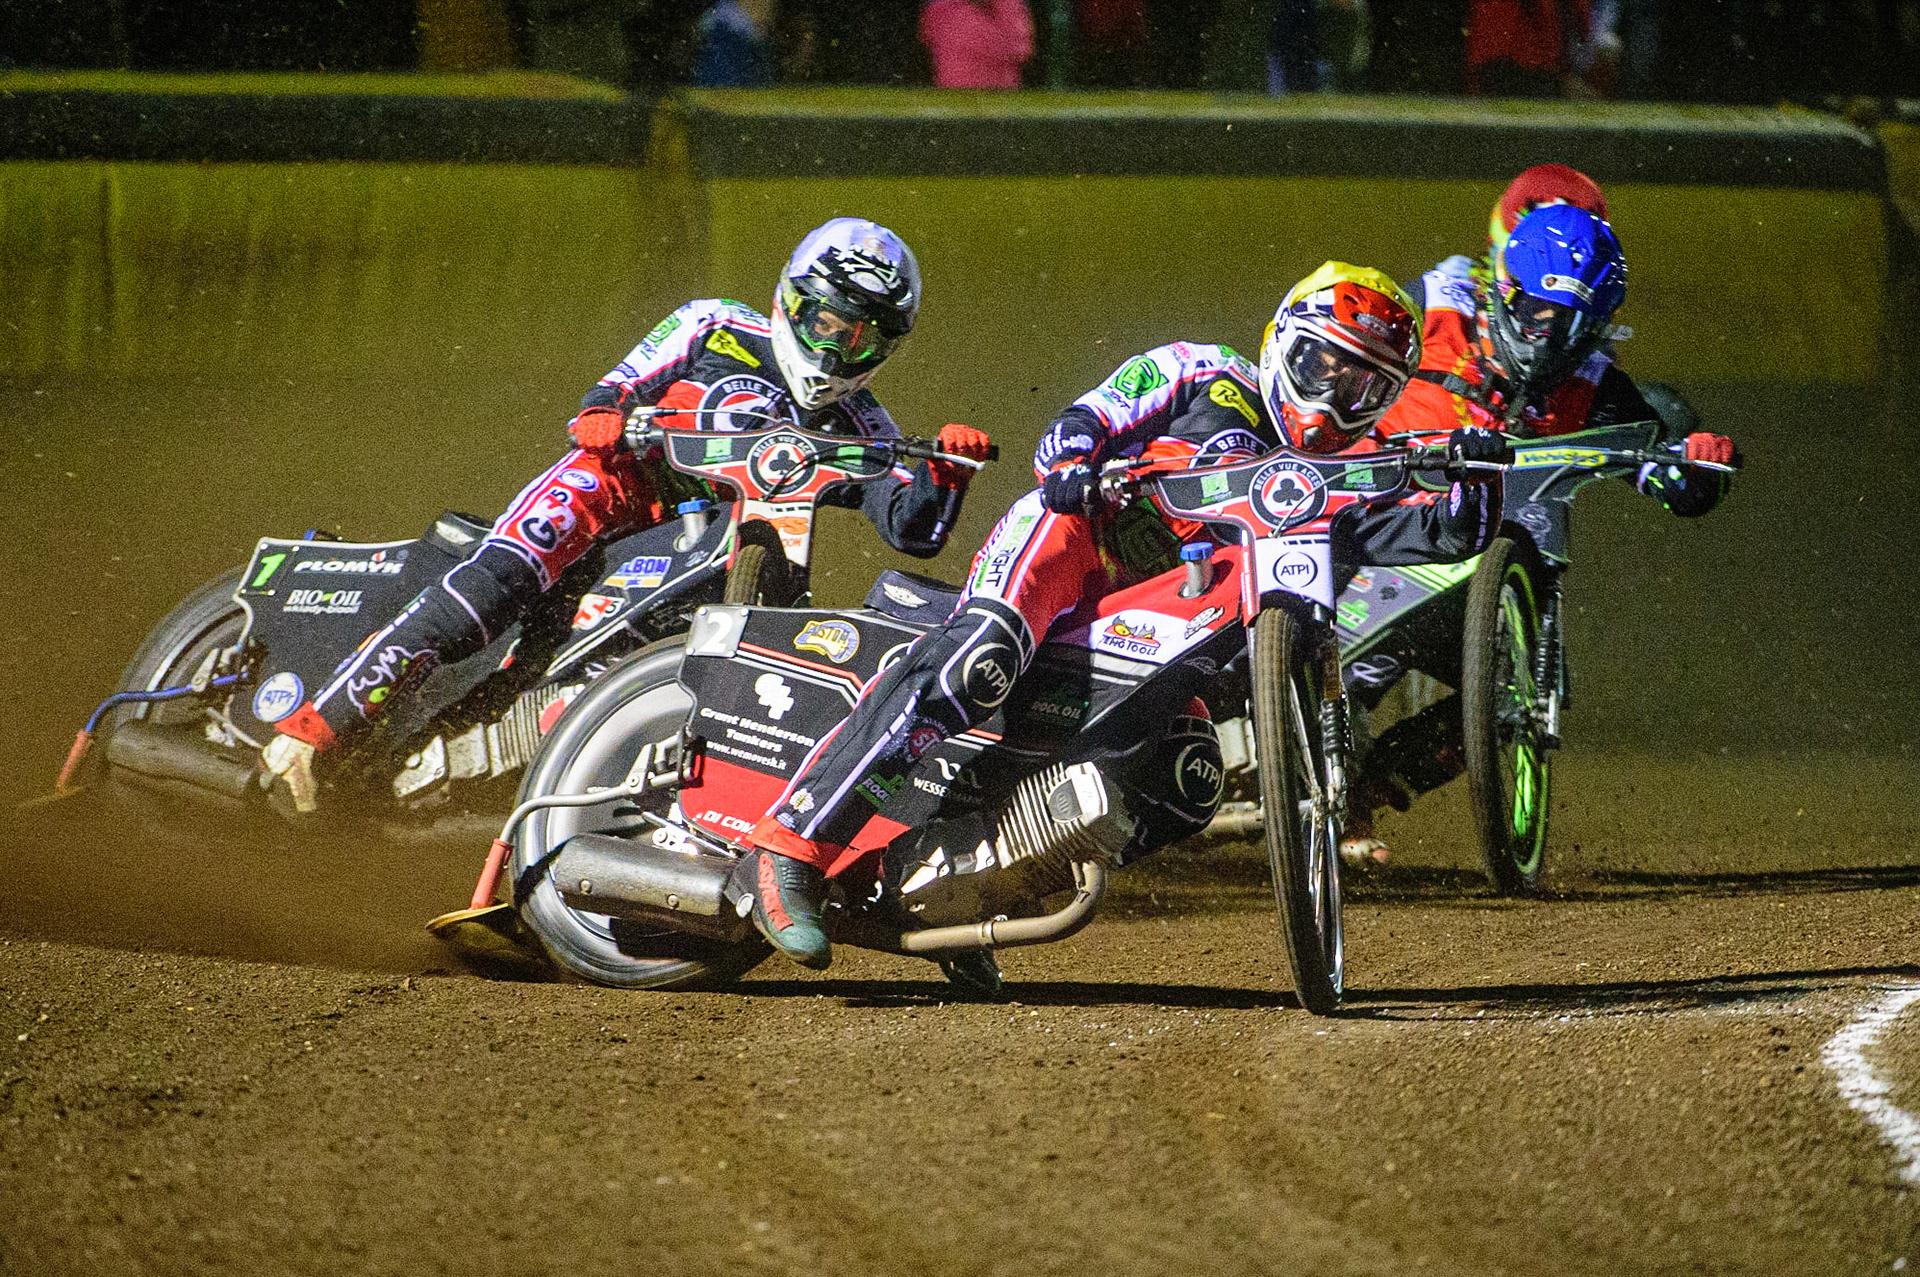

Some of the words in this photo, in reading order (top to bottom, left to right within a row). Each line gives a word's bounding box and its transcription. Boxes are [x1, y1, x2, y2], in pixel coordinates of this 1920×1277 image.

[722, 380, 762, 394] BELLE
[1215, 436, 1258, 451] BELLE
[1254, 466, 1276, 491] BELLE
[1278, 463, 1298, 471] VUE
[1300, 468, 1321, 489] ACES
[252, 553, 287, 587] 1
[1280, 563, 1310, 577] ATPI
[703, 611, 734, 653] 2
[975, 658, 1010, 696] ATPI
[700, 707, 740, 725] Grant
[739, 717, 816, 748] Henderson
[726, 728, 783, 753] Tankers
[1185, 757, 1221, 790] ATPI
